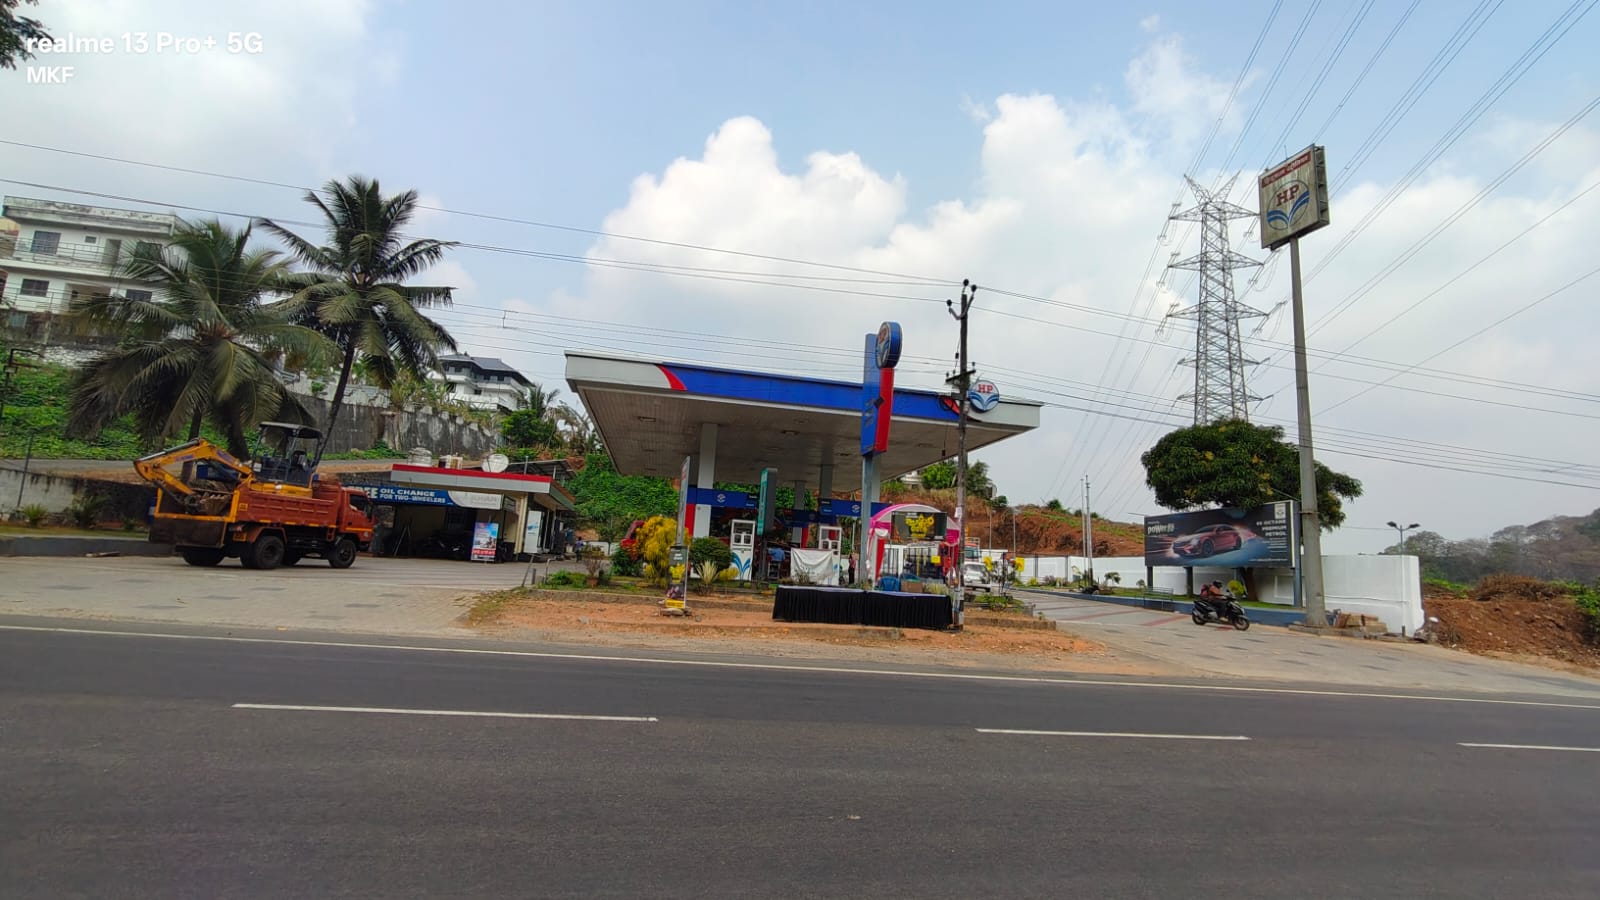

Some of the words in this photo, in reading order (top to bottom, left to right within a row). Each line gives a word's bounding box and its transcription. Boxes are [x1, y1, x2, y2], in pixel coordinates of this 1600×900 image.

[1276, 184, 1300, 207] HP
[977, 383, 994, 394] HP
[397, 489, 436, 497] CHANGE
[394, 495, 446, 503] TWO-WHEELERS
